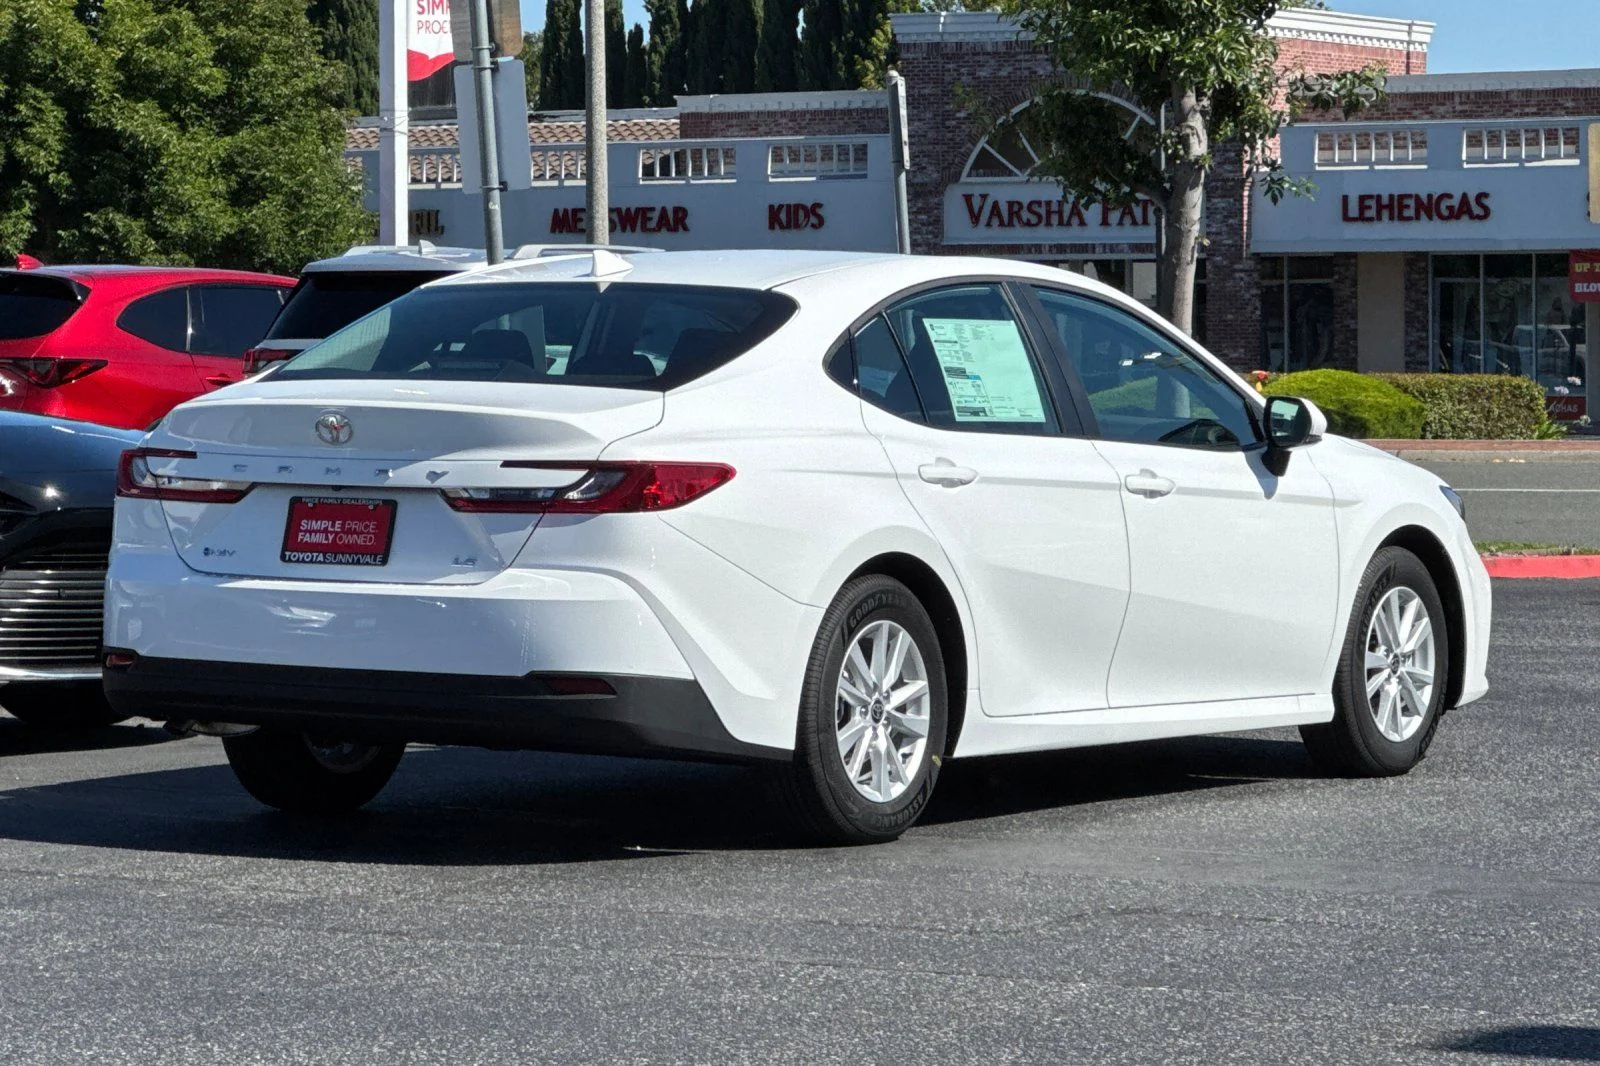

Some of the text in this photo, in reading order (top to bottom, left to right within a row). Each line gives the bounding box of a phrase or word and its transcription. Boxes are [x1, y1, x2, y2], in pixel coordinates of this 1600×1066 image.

[768, 202, 825, 231] KIDS
[962, 193, 1088, 228] VARSHA
[1341, 192, 1491, 223] LEHENGAS
[550, 206, 690, 233] MESWEAR
[1575, 283, 1600, 293] BLO
[300, 520, 379, 533] SIMPLE PRICE.
[297, 532, 335, 544] FAMILY
[284, 551, 383, 564] TOYOTA SUNNYVALE
